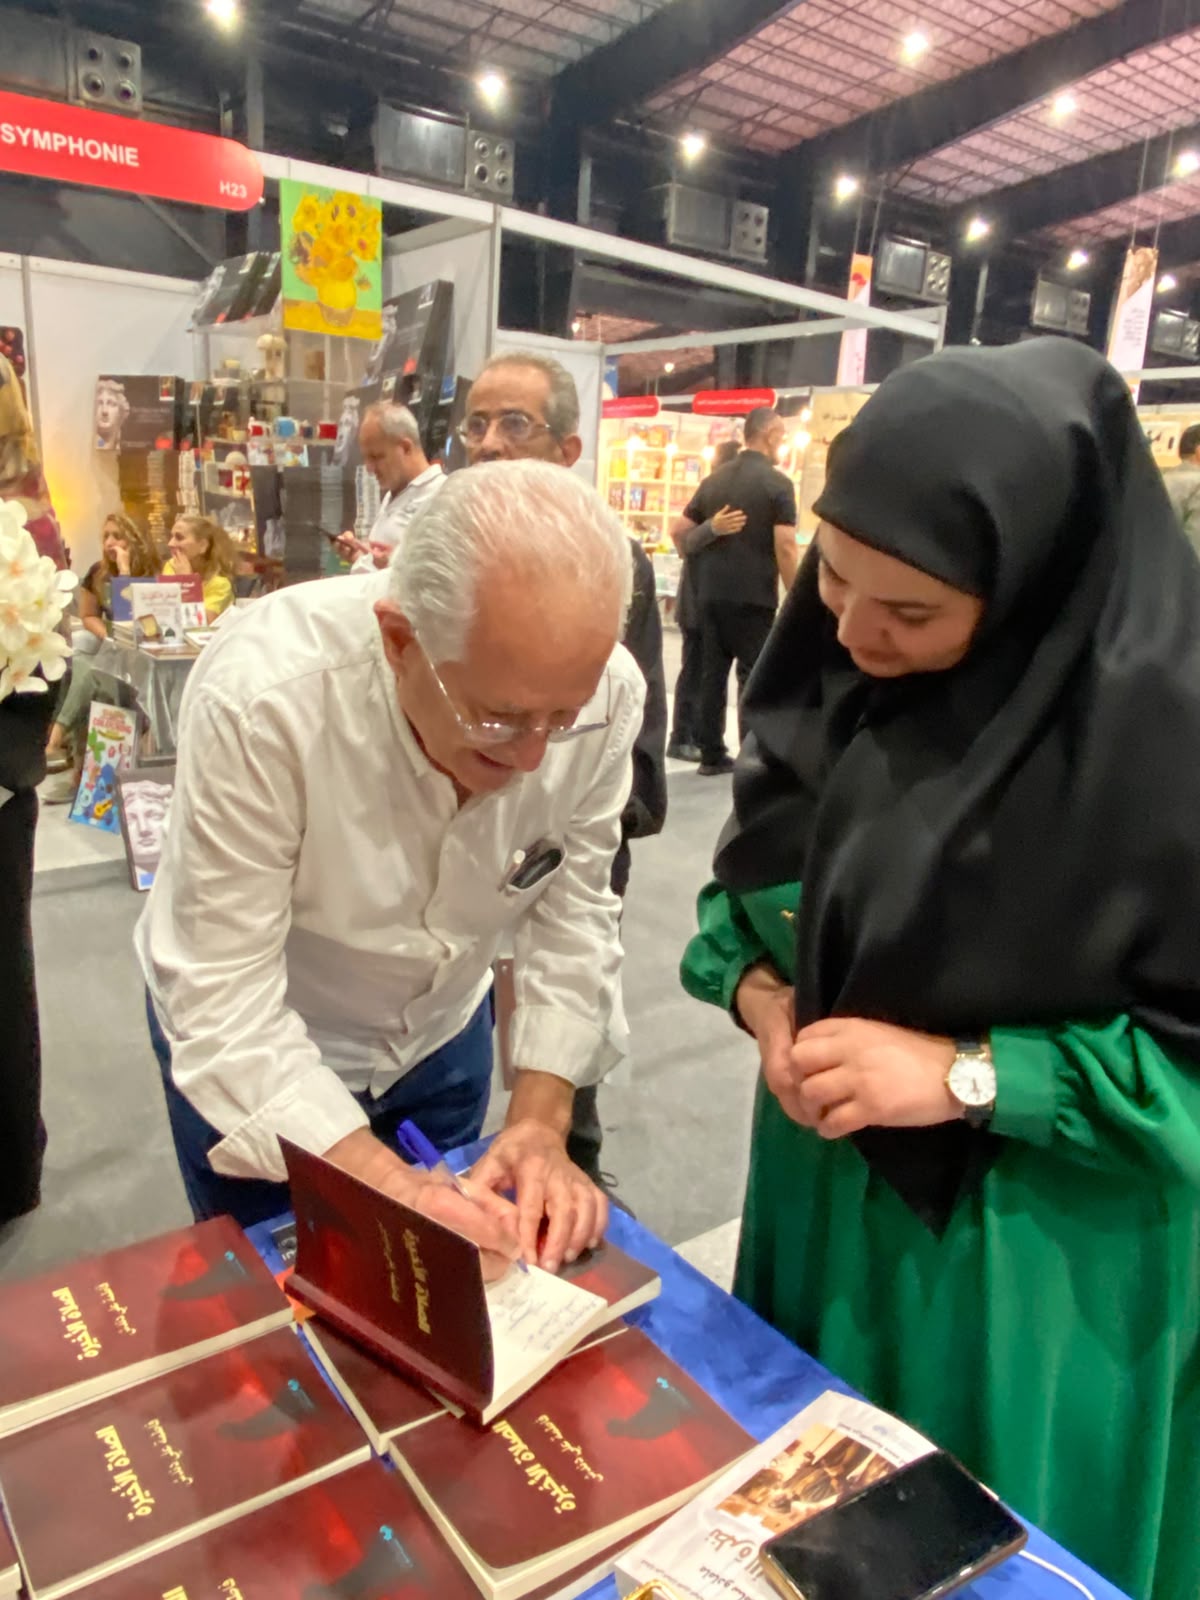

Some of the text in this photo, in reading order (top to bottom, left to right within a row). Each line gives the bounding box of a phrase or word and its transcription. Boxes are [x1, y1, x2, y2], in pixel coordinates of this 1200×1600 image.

[1, 122, 140, 168] SYMPHONIE
[219, 180, 248, 199] H23
[52, 1286, 102, 1361] الصلاة الأخيرة
[143, 1418, 168, 1447] فاطمة
[160, 1443, 183, 1461] علي
[535, 1414, 564, 1443] فاطمة
[559, 1439, 583, 1458] علي
[95, 1424, 156, 1522] الصلاة الأخيرة
[491, 1419, 578, 1515] الصلاة الأخيرة
[704, 1528, 756, 1563] نظرة
[699, 1565, 735, 1589] مامادو
